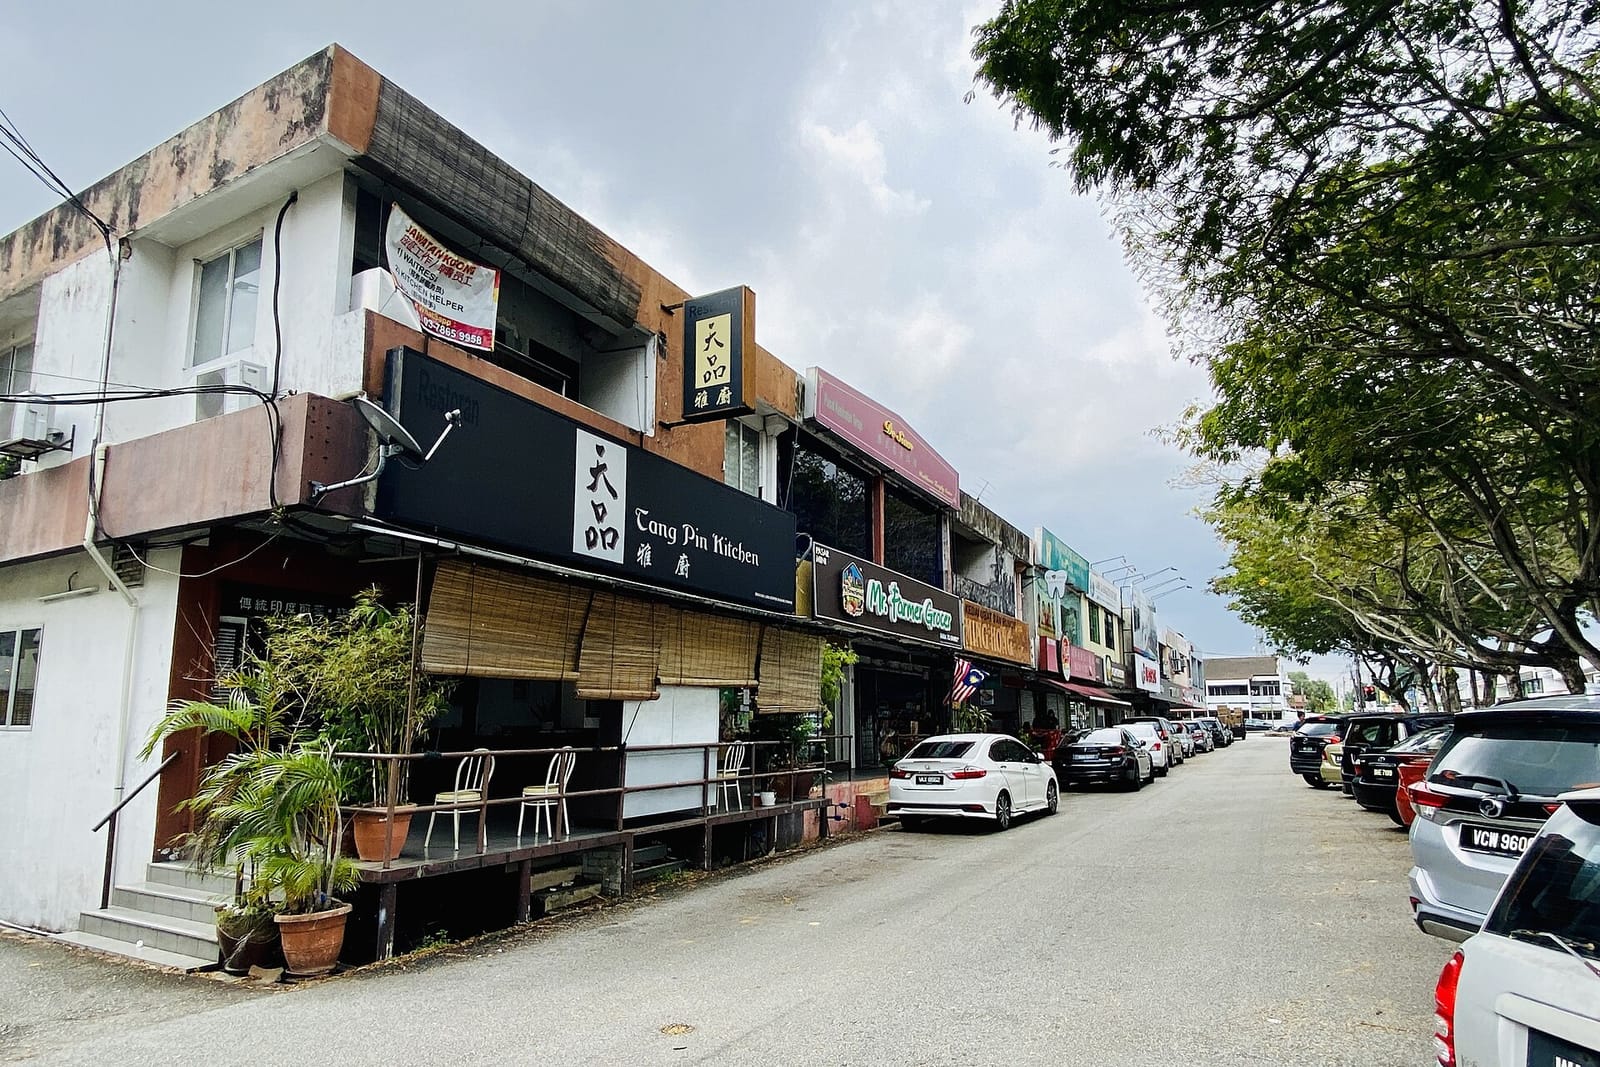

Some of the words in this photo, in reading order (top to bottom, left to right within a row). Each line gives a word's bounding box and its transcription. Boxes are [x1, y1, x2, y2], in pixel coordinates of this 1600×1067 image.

[405, 224, 444, 260] JAWATAN
[429, 291, 464, 313] HELPER
[458, 331, 482, 345] 9958
[634, 507, 678, 546] Tang
[682, 523, 708, 551] Pin
[712, 532, 759, 567] Kitchen
[923, 598, 952, 631] Grocer
[1473, 829, 1499, 848] VCW
